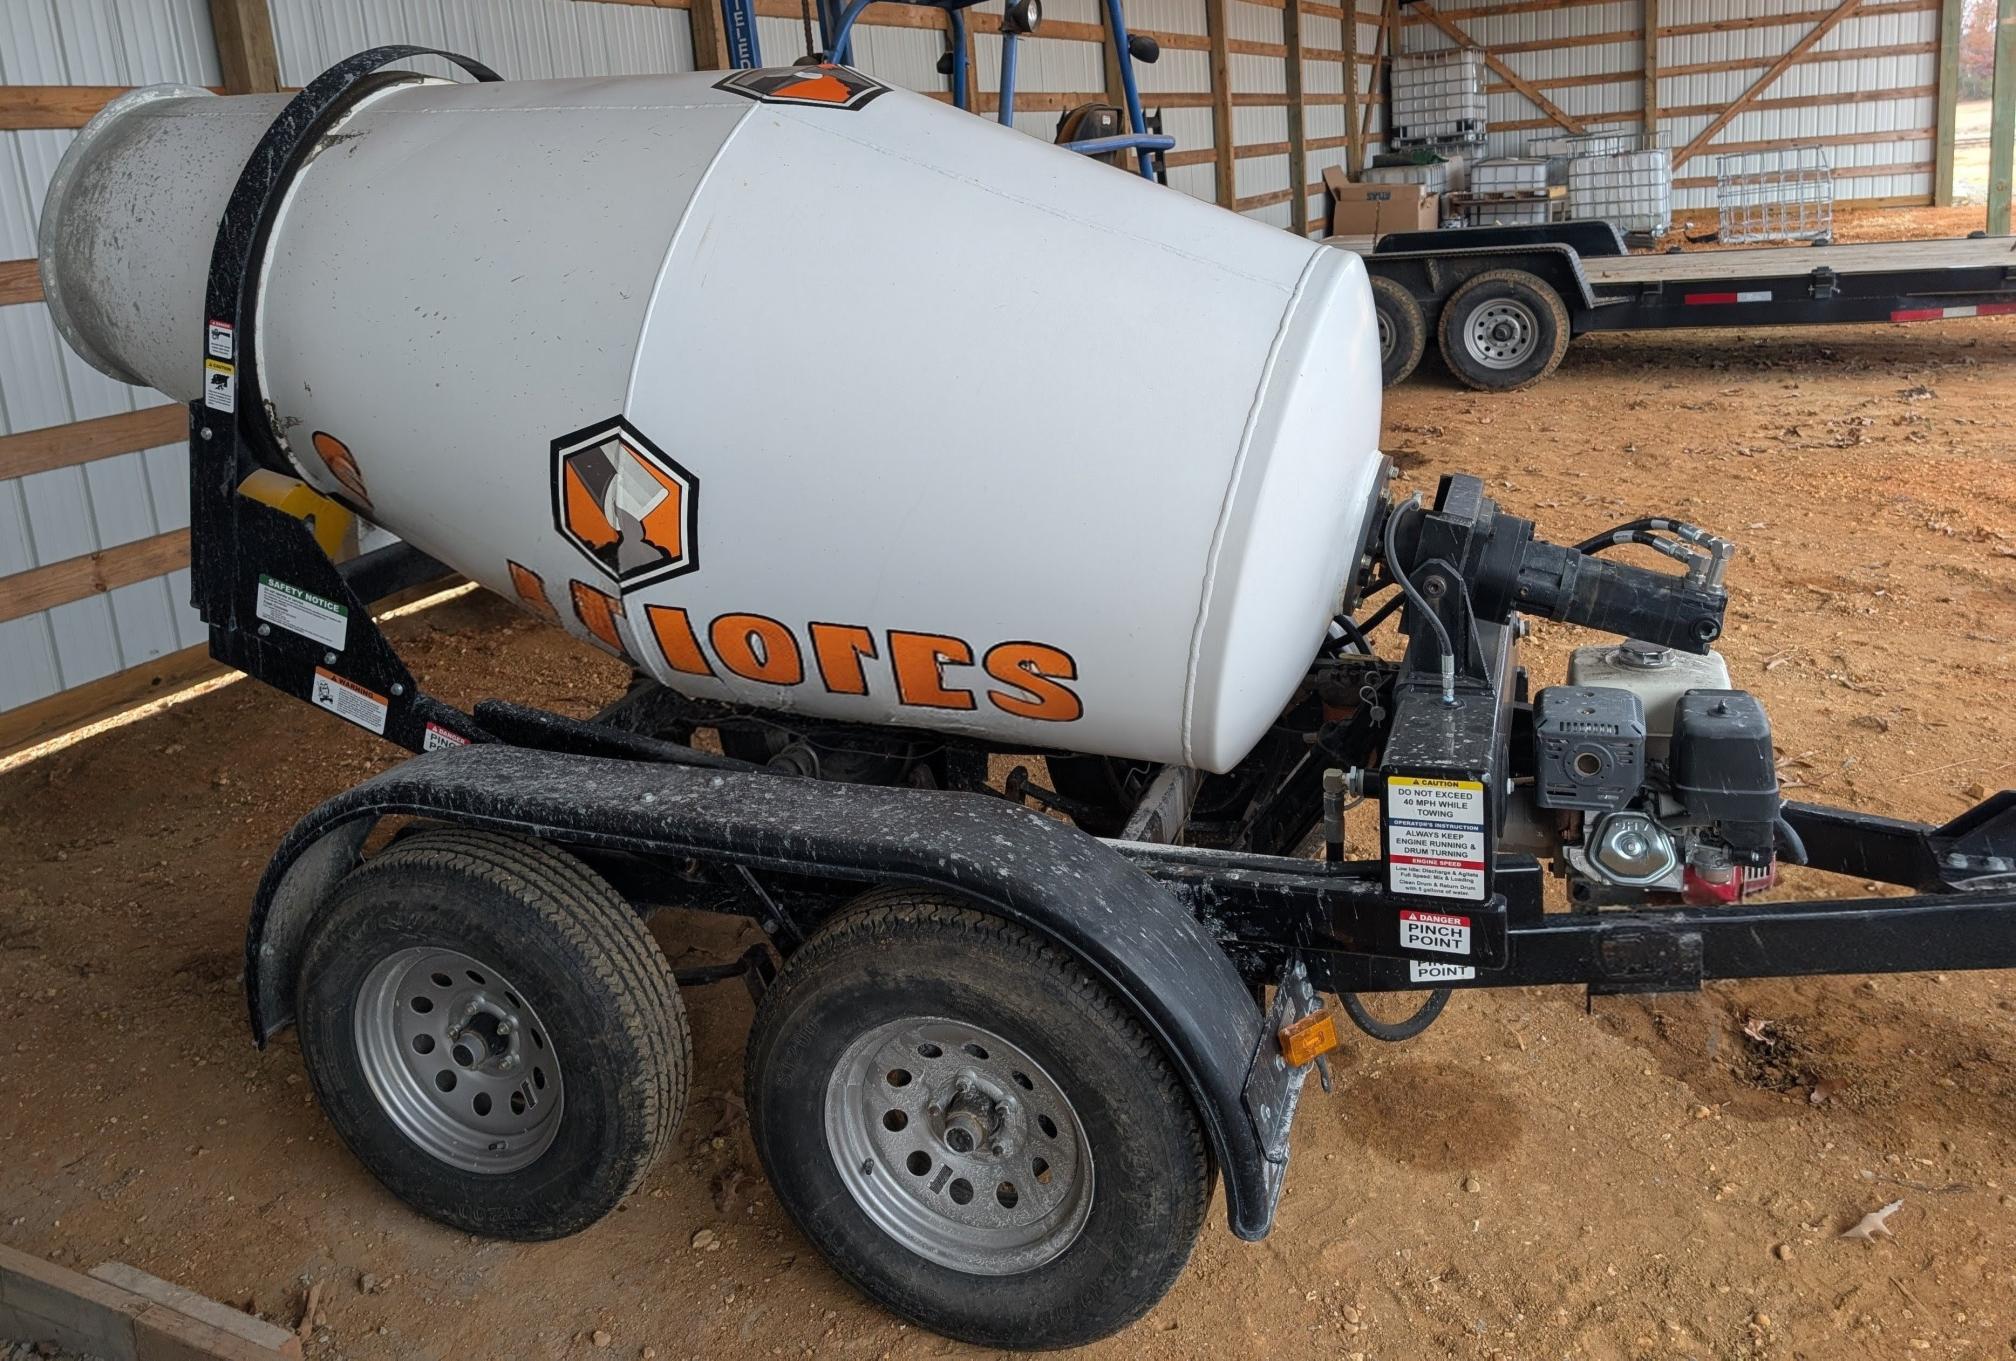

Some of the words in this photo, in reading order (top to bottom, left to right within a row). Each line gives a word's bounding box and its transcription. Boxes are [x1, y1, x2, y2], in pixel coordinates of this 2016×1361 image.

[268, 578, 304, 598] SAFETY
[305, 592, 340, 613] NOTICE
[339, 678, 374, 699] WARNING
[439, 728, 465, 744] DANGER
[1421, 779, 1459, 788] CAUTION
[1398, 788, 1412, 796] DO
[1414, 790, 1433, 798] NOT
[1435, 791, 1473, 800] EXCEED
[1403, 798, 1414, 806] 40
[1416, 800, 1436, 808] MPH
[1438, 801, 1468, 810] WHILE
[1417, 808, 1454, 818] TOWING
[1393, 820, 1434, 828] OPERATOR'S
[1434, 822, 1479, 831] INSTRUCTION
[1405, 830, 1439, 839] ALWAYS
[1441, 832, 1464, 840] KEEP
[1396, 838, 1428, 847] ENGINE
[1429, 840, 1468, 850] RUNNING
[1404, 847, 1429, 855] DRUM
[1431, 849, 1469, 858] TURNING
[1412, 858, 1438, 866] ENGINE
[1439, 860, 1462, 868] SPEED
[1422, 868, 1451, 876] Discharge
[1451, 876, 1475, 884] Loading
[1420, 914, 1462, 925] DANGER
[1408, 923, 1463, 938] PINCH
[1409, 934, 1463, 949] POINT
[1419, 966, 1468, 978] POINT
